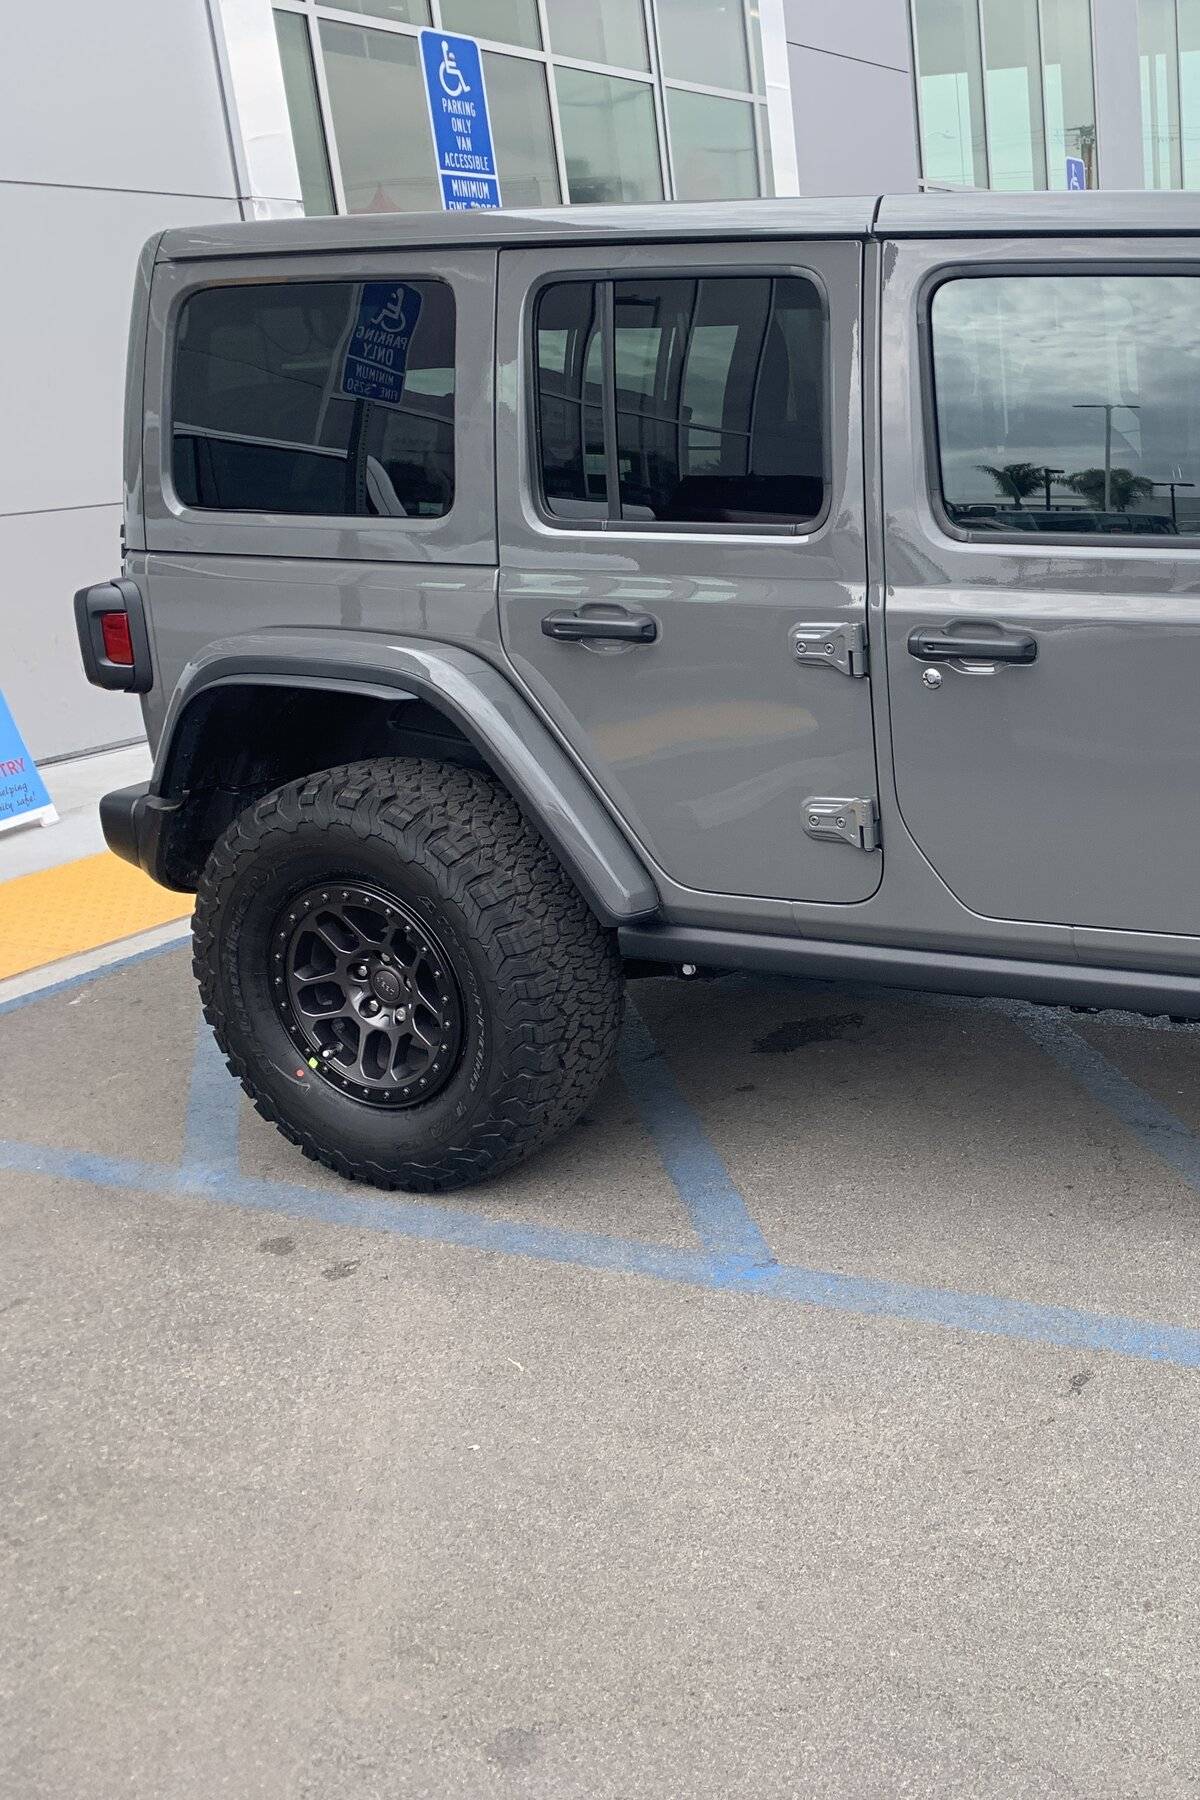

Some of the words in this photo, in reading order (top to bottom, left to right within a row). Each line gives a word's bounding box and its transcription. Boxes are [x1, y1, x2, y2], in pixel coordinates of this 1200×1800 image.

[441, 98, 476, 116] PARKING
[451, 117, 471, 134] ONLY
[456, 137, 472, 152] VAN
[444, 153, 490, 171] ACCESSIBLE
[451, 179, 490, 199] MINIMUM
